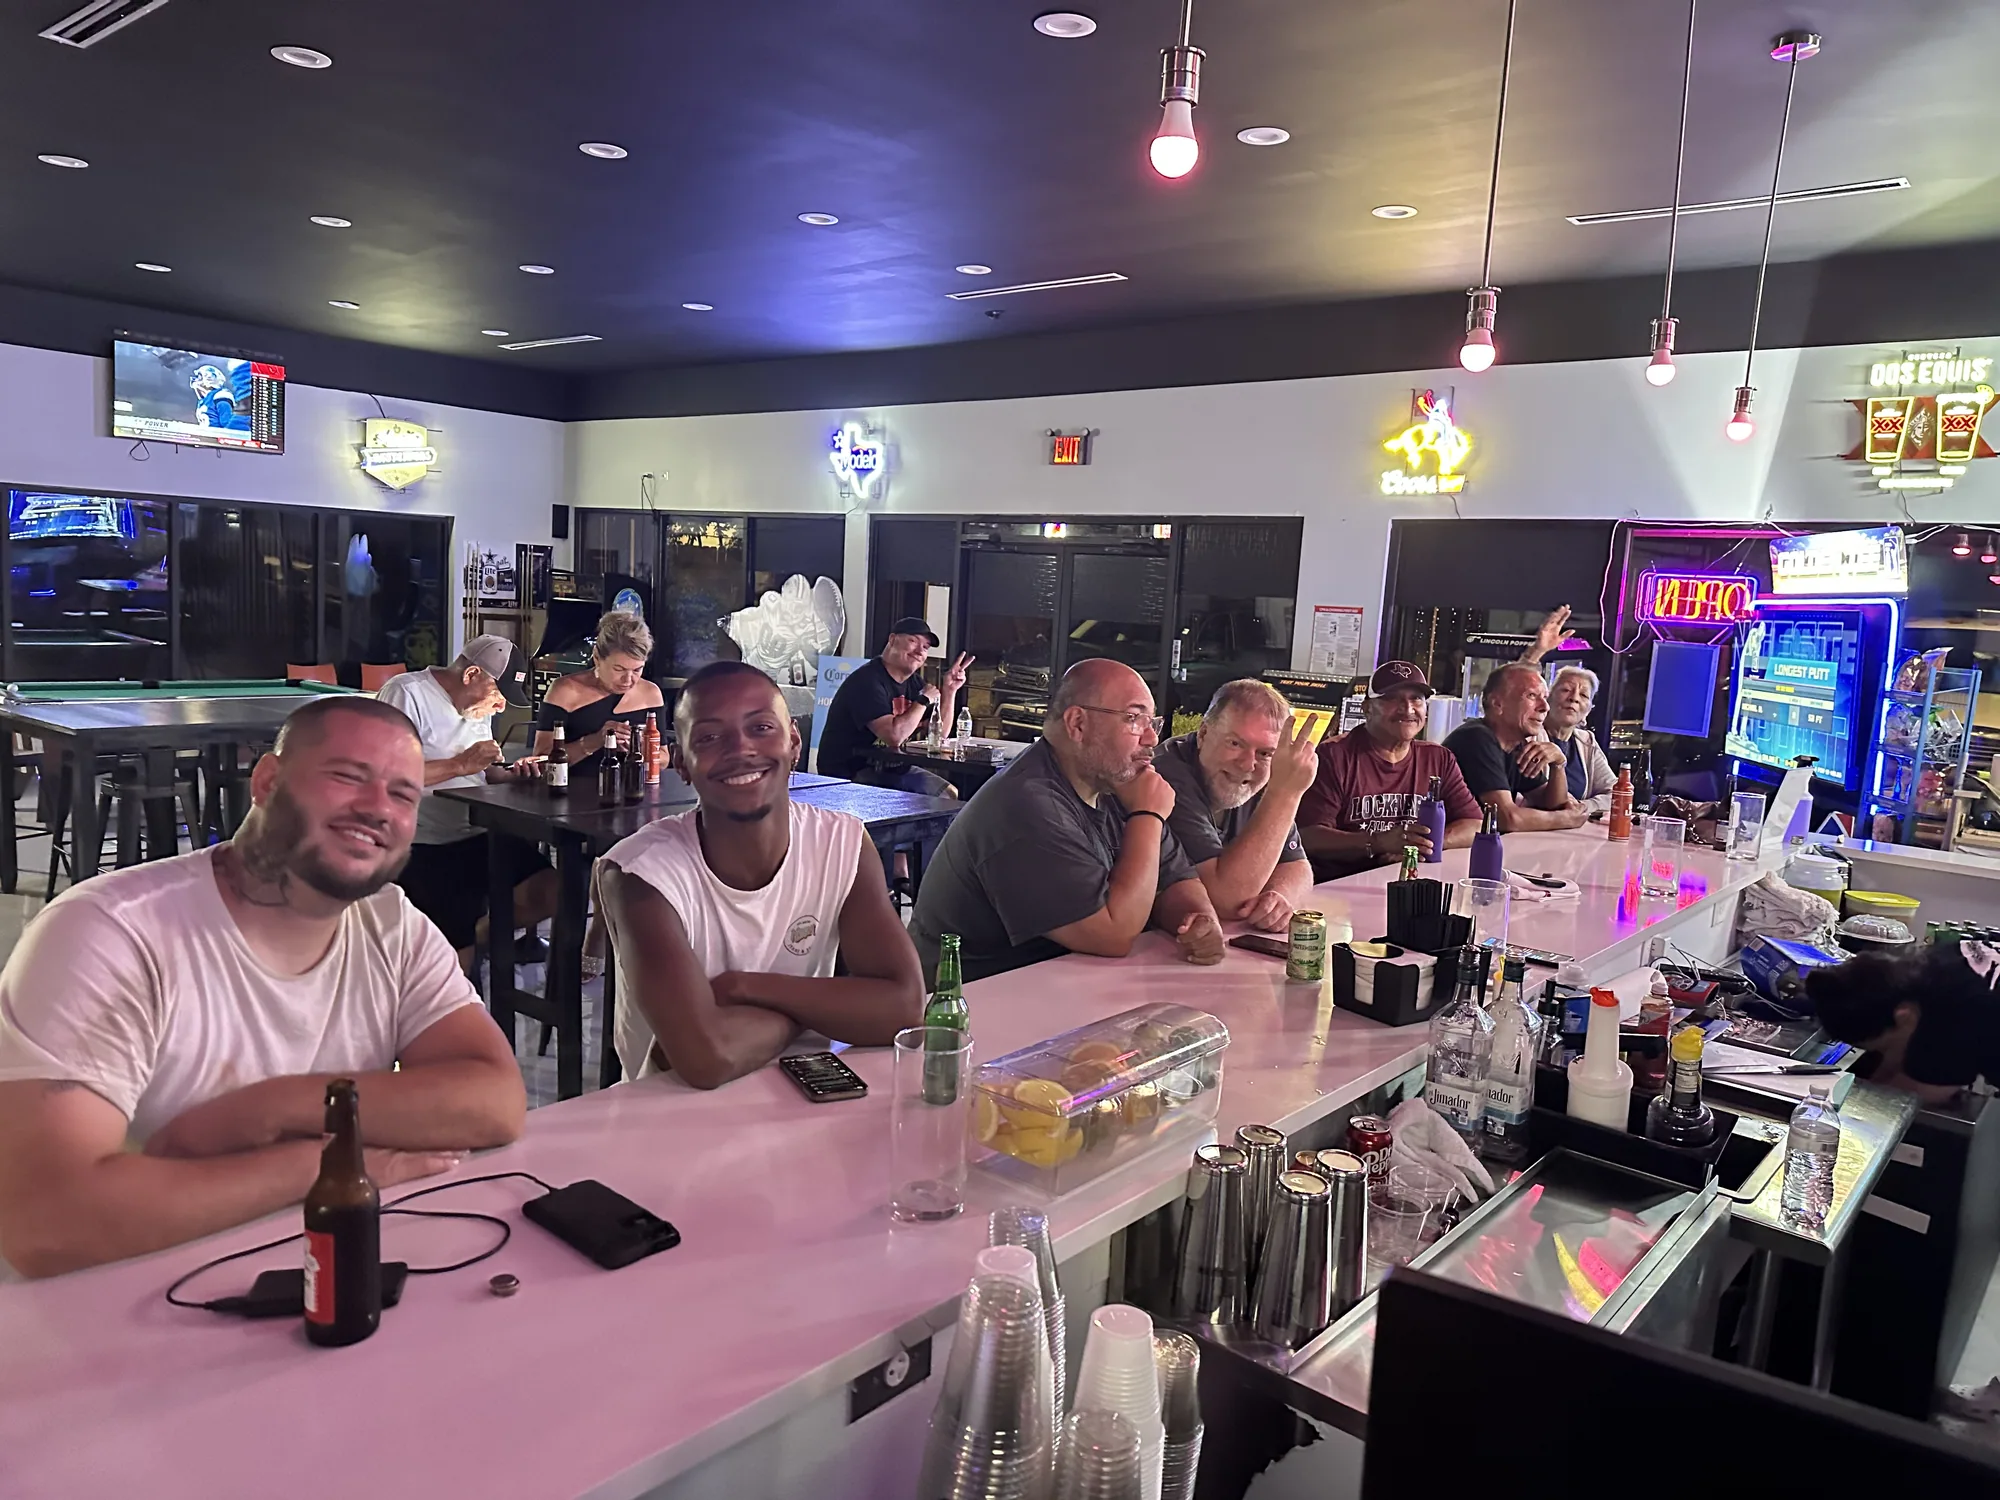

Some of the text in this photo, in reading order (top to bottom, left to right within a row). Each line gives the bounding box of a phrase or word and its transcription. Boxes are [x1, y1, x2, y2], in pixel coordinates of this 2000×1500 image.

[1869, 358, 1988, 387] DOS EQUIS
[1871, 416, 1905, 433] XX
[1941, 414, 1977, 431] XX
[1054, 437, 1081, 463] EXIT
[1773, 663, 1830, 681] LONGEST PUTT
[1430, 1089, 1471, 1109] Jimador
